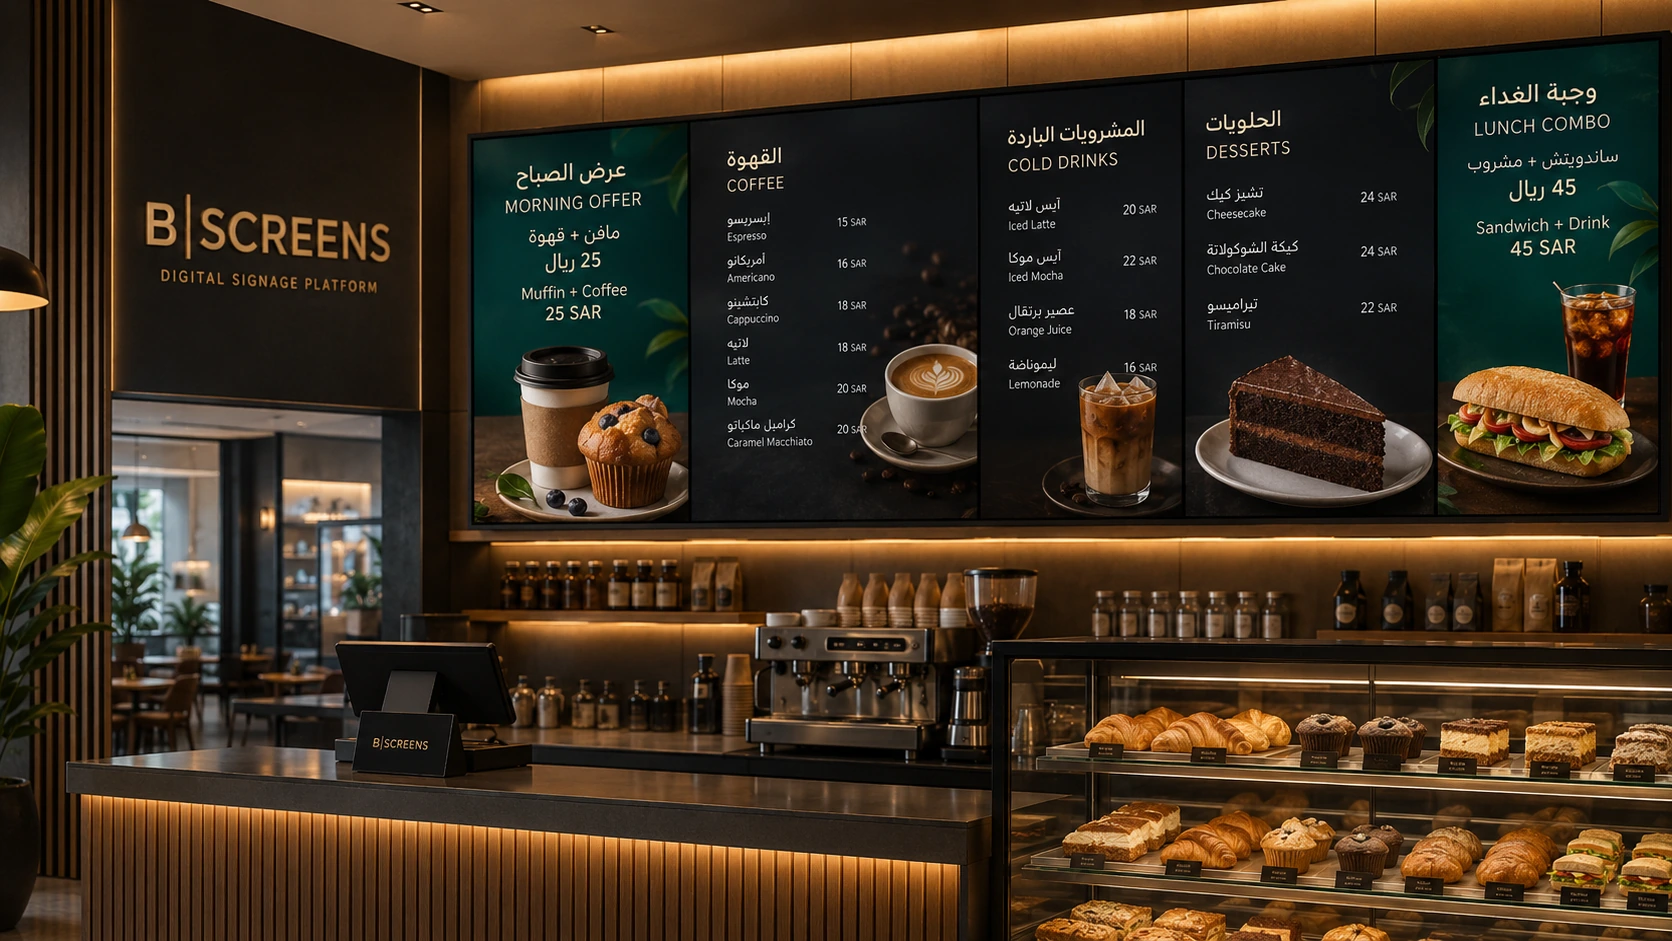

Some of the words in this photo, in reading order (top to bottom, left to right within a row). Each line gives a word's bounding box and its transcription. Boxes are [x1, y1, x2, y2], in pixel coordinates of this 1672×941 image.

[1480, 84, 1538, 106] الغداء
[1547, 83, 1596, 105] وجبة
[1206, 110, 1280, 134] الحلويات
[1475, 119, 1534, 136] LUNCH
[1542, 114, 1610, 132] COMBO
[1008, 126, 1054, 148] الباردة
[1207, 141, 1290, 159] DESSERTS
[727, 147, 781, 171] القهوة
[1009, 157, 1052, 172] COLD
[1059, 152, 1117, 169] DRINKS
[1468, 155, 1522, 173] مشروب
[1528, 157, 1536, 166] +
[1542, 150, 1618, 169] ساندويتش
[517, 163, 572, 190] الصباح
[580, 163, 625, 184] عرض
[727, 176, 784, 192] COFFEE
[1510, 180, 1544, 202] ريال
[1552, 179, 1576, 195] 45
[1207, 188, 1231, 203] كيك
[1235, 187, 1263, 202] تشيز
[1361, 191, 1374, 202] 24
[1378, 192, 1397, 202] SAR
[506, 196, 582, 213] MORNING
[590, 192, 641, 208] OFFER
[1009, 200, 1031, 214] لاتيه
[1036, 197, 1060, 213] آيس
[1123, 204, 1136, 215] 20
[1139, 204, 1157, 214] SAR
[1207, 208, 1266, 220] Cheesecake
[838, 217, 848, 227] 15
[851, 218, 866, 226] SAR
[1009, 220, 1028, 230] Iced
[1032, 220, 1055, 229] Latte
[1477, 218, 1548, 234] Sandwich
[1555, 220, 1563, 229] +
[1570, 215, 1610, 230] Drink
[529, 228, 564, 247] قهوة
[571, 231, 579, 240] +
[585, 225, 619, 244] مافن
[728, 232, 767, 243] Espresso
[1207, 241, 1266, 258] الشوكولاتة
[1271, 240, 1298, 255] كيكة
[1361, 246, 1374, 257] 24
[1378, 246, 1397, 256] SAR
[1511, 241, 1532, 256] 45
[1540, 239, 1575, 255] SAR
[546, 253, 574, 273] ريال
[581, 252, 600, 268] 25
[727, 252, 765, 268] أمريكانو
[838, 258, 848, 268] 16
[851, 259, 866, 268] SAR
[1009, 252, 1033, 266] موكا
[1037, 249, 1061, 265] آيس
[1123, 255, 1136, 266] 22
[1139, 256, 1157, 265] SAR
[1207, 263, 1258, 275] Chocolate
[1261, 262, 1286, 272] Cake
[161, 269, 224, 285] DIGITAL
[232, 273, 297, 289] SIGNAGE
[305, 278, 377, 293] PLATFORM
[727, 273, 775, 282] Americano
[1009, 272, 1028, 282] Iced
[1032, 270, 1063, 281] Mocha
[522, 286, 564, 300] Muffin
[570, 288, 577, 297] +
[583, 283, 627, 297] Coffee
[727, 296, 768, 310] كابتشينو
[838, 300, 848, 310] 18
[851, 301, 866, 310] SAR
[1208, 298, 1258, 314] تيراميسو
[1361, 302, 1374, 313] 22
[1378, 303, 1397, 313] SAR
[546, 306, 564, 321] 25
[570, 305, 601, 320] SAR
[727, 313, 779, 326] Cappuccino
[1009, 305, 1041, 320] برتقال
[1045, 307, 1074, 318] عصير
[1124, 309, 1136, 319] 18
[1139, 310, 1157, 319] SAR
[1009, 326, 1044, 338] Orange
[1047, 324, 1072, 334] Juice
[1207, 319, 1250, 330] Tiramisu
[838, 342, 848, 352] 18
[851, 343, 866, 352] SAR
[728, 356, 750, 365] Latte
[1009, 358, 1056, 372] ليموناضة
[1124, 362, 1136, 372] 16
[1138, 363, 1157, 372] SAR
[728, 379, 749, 391] موكا
[837, 383, 848, 393] 20
[851, 384, 866, 393] SAR
[1009, 378, 1060, 389] Lemonade
[728, 396, 757, 406] Mocha
[764, 419, 795, 432] كراميل
[837, 424, 848, 434] 20
[727, 437, 764, 447] Caramel
[767, 437, 813, 446] Macchiato
